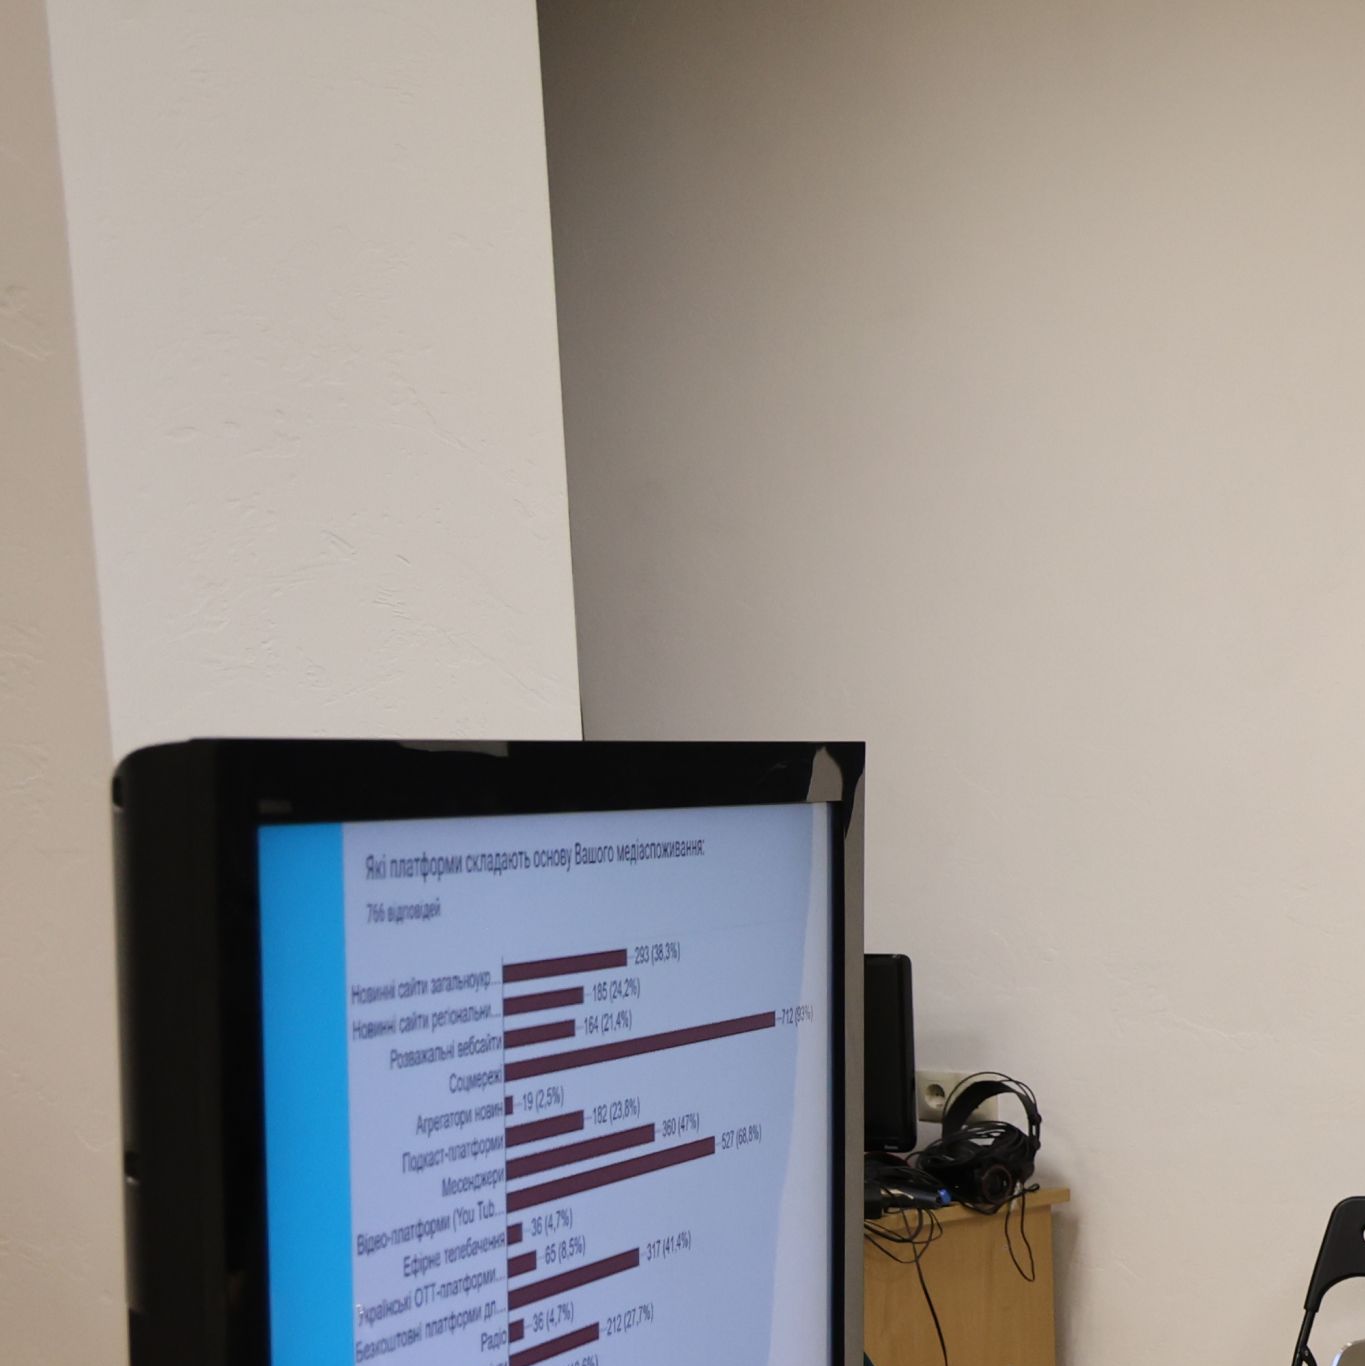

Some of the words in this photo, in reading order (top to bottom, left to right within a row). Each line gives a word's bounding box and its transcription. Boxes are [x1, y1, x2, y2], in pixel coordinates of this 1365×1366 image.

[365, 853, 386, 880] Які
[390, 852, 462, 883] платформи
[465, 850, 531, 876] складають
[533, 848, 572, 872] основу
[574, 842, 614, 865] Вашого
[616, 838, 705, 866] медіаспоживання:
[366, 903, 386, 924] 766
[387, 897, 441, 924] відповідей
[634, 946, 649, 964] 293
[351, 979, 396, 1005] Новинні
[398, 977, 428, 999] сайти
[352, 1014, 396, 1041] Новинні
[399, 1011, 429, 1034] сайти
[584, 1016, 599, 1035] 164
[781, 1008, 794, 1026] 712
[390, 1038, 455, 1070] Розважальні
[457, 1033, 502, 1059] вебсайти
[449, 1069, 502, 1094] Соцмережі
[523, 1092, 533, 1112] 19
[535, 1086, 564, 1113] (2,5%)
[416, 1108, 473, 1138] Агрегатори
[475, 1101, 503, 1121] новин
[662, 1119, 677, 1137] 360
[677, 1112, 700, 1137] (47%)
[402, 1135, 504, 1174] Подкаст-платформи
[721, 1132, 735, 1150] 527
[442, 1167, 505, 1197] Месенджери
[357, 1215, 450, 1257] Відео-платформи
[452, 1205, 475, 1232] (You
[544, 1208, 573, 1237] (4,7%)
[403, 1251, 441, 1278] Ефірне
[443, 1232, 505, 1265] телебачення
[546, 1301, 574, 1333] (4,7%)
[606, 1317, 622, 1336] 212
[623, 1303, 654, 1334] (27,7%)
[355, 1322, 423, 1364] Безкоштовні
[425, 1306, 482, 1337] платформи
[481, 1327, 507, 1352] Радіо
